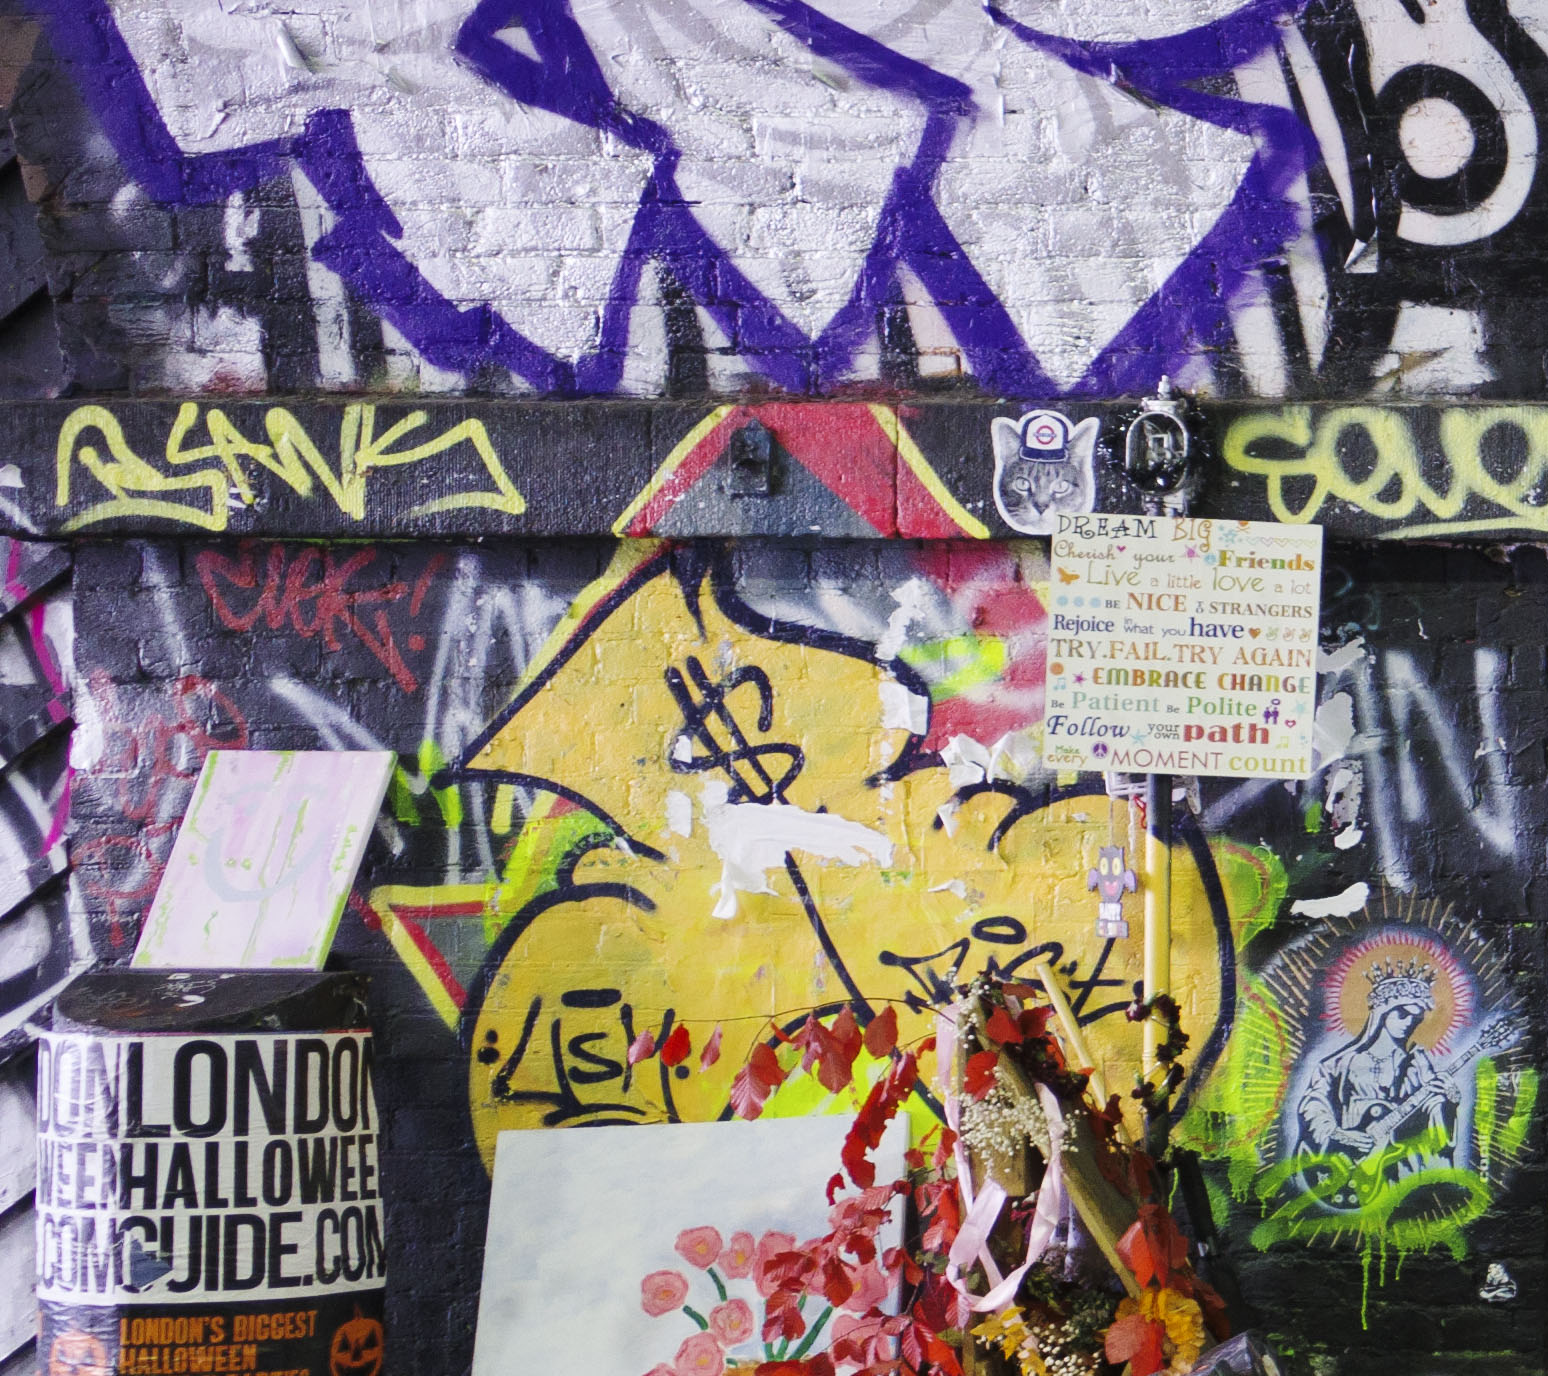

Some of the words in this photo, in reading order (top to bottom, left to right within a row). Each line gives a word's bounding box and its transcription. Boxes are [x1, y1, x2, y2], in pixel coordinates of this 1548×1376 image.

[1057, 514, 1158, 540] DREAM
[1171, 517, 1212, 553] BIG
[1054, 540, 1116, 561] Cherish
[1134, 553, 1176, 570] your
[1217, 549, 1315, 572] Friends
[1086, 561, 1141, 587] Live
[1150, 578, 1159, 588] a
[1167, 572, 1202, 590] little
[1212, 567, 1265, 593] love
[1274, 583, 1283, 594] a
[1291, 580, 1312, 595] lot
[1105, 599, 1121, 609] BE
[1126, 592, 1187, 613] NICE
[1208, 601, 1313, 618] STRANGERS
[1053, 614, 1115, 636] Rejoice
[1124, 623, 1154, 636] what
[1162, 626, 1186, 640] you
[1189, 617, 1245, 639] have
[1232, 647, 1312, 668] AGAIN
[1092, 667, 1207, 690] EMBRACE
[1217, 671, 1311, 694] CHANGE
[1051, 700, 1064, 709] Be
[1071, 692, 1161, 713] Patient
[1167, 704, 1180, 714] Be
[1186, 697, 1257, 717] Polite
[1047, 715, 1130, 738] Follow
[1148, 723, 1179, 735] your
[1154, 732, 1179, 740] own
[1184, 723, 1270, 745] path
[1047, 753, 1088, 767] every
[1110, 749, 1223, 770] MOMENT
[1229, 756, 1307, 773] count
[118, 1137, 380, 1210] HALLOWEE
[120, 1315, 225, 1345] LONDON'S
[233, 1310, 318, 1342] BIGGEST
[119, 1344, 257, 1374] HALLOWEEN
